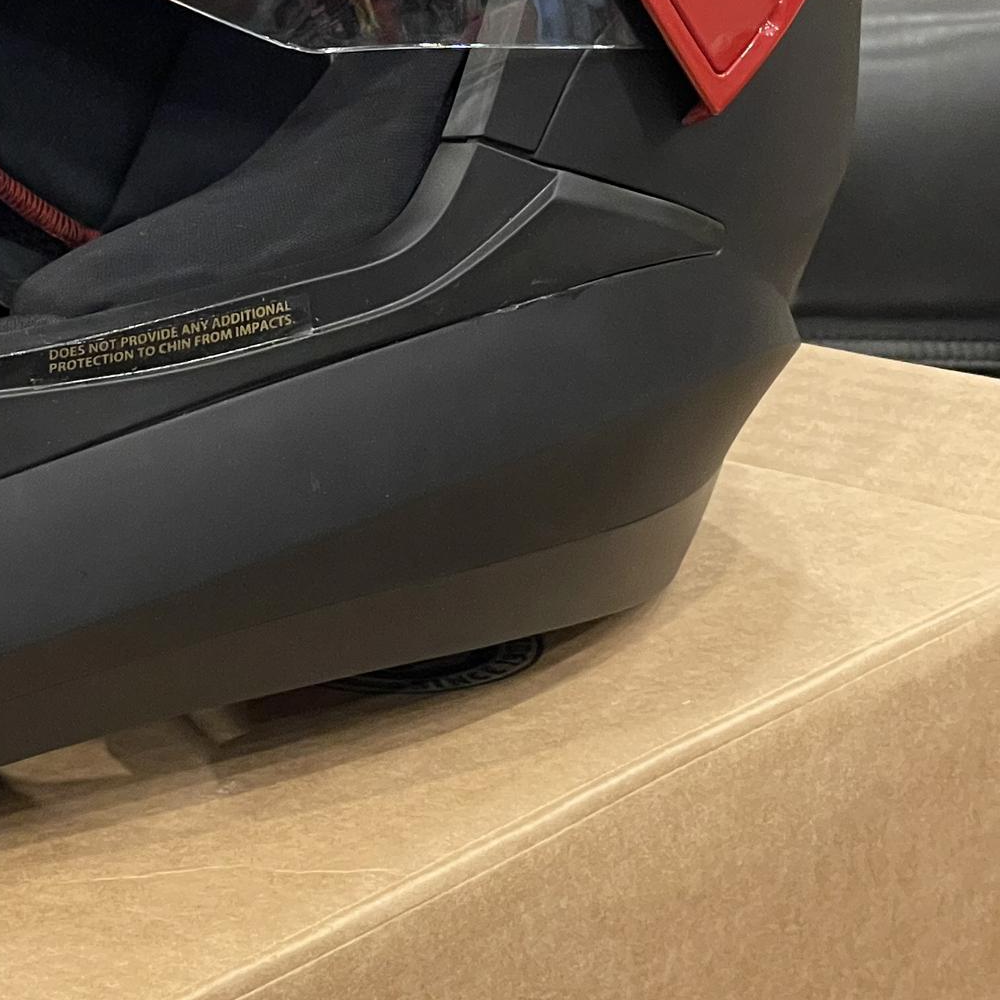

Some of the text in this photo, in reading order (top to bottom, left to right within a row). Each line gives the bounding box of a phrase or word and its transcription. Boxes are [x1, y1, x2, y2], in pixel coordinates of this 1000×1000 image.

[49, 314, 296, 374] PROTECTION TO CHIN FROM IMPACTS.
[50, 301, 292, 361] DOES NOT PROVIDE ANY ADDITIONAL
